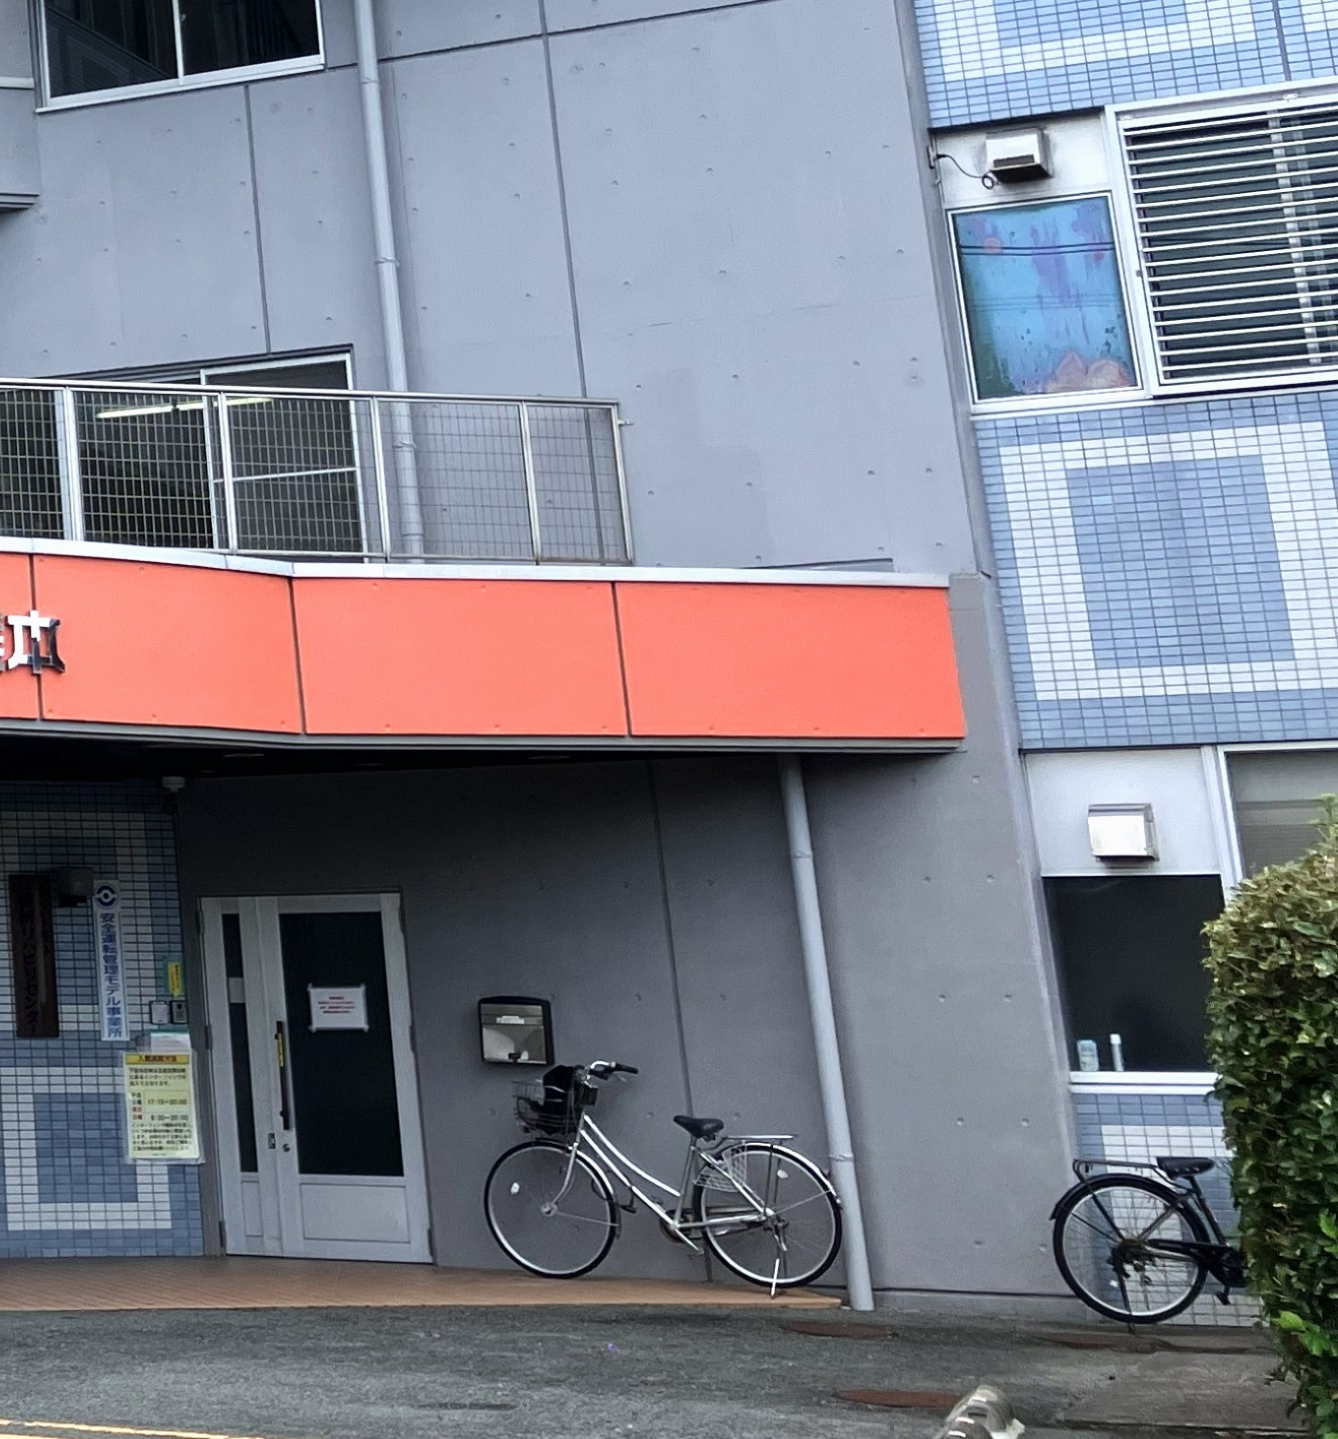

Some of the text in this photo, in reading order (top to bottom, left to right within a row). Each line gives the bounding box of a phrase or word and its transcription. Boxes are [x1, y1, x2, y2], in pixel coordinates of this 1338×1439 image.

[100, 913, 122, 1038] 安全運転管理モデル事業所
